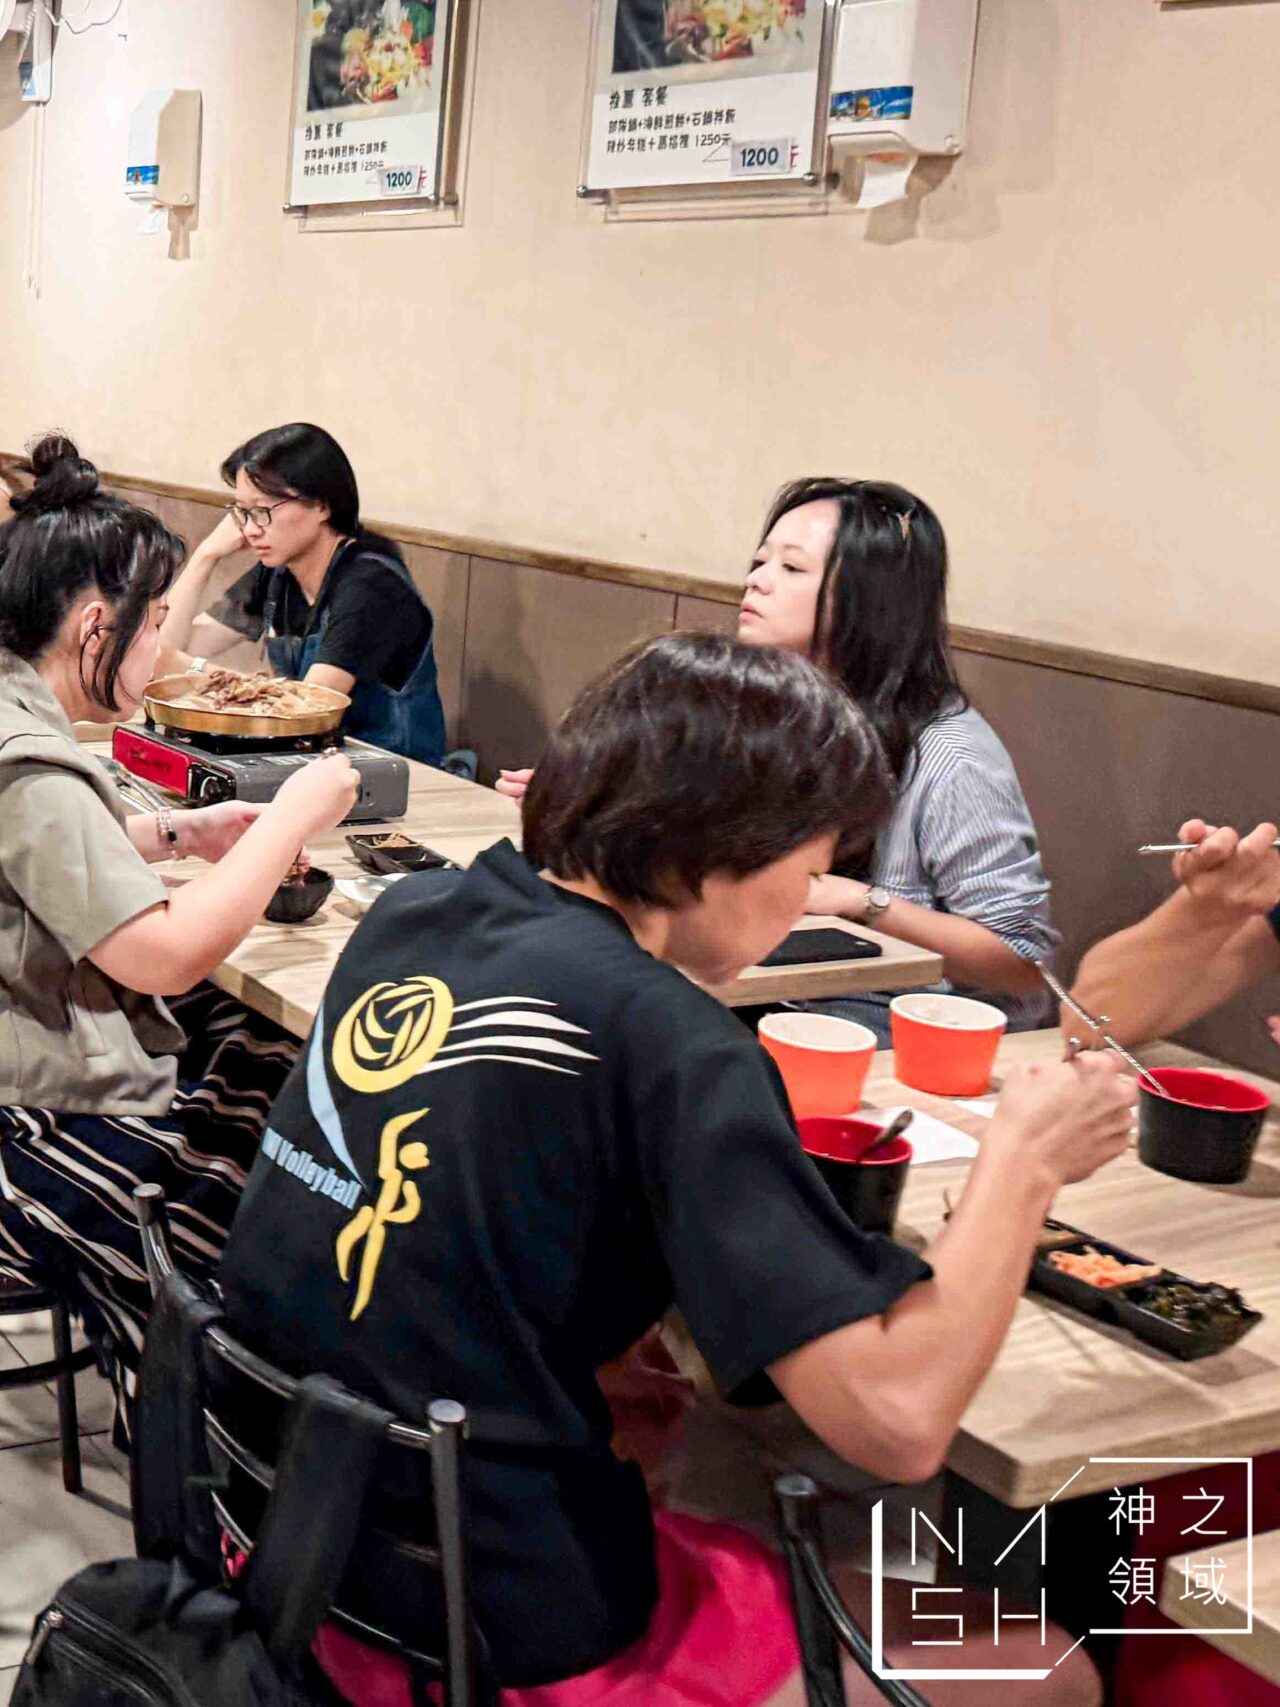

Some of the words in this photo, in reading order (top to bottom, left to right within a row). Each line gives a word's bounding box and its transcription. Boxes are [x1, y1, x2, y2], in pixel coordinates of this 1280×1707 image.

[740, 147, 779, 167] 1200
[386, 171, 412, 187] 1200
[276, 1140, 363, 1210] Volleyball
